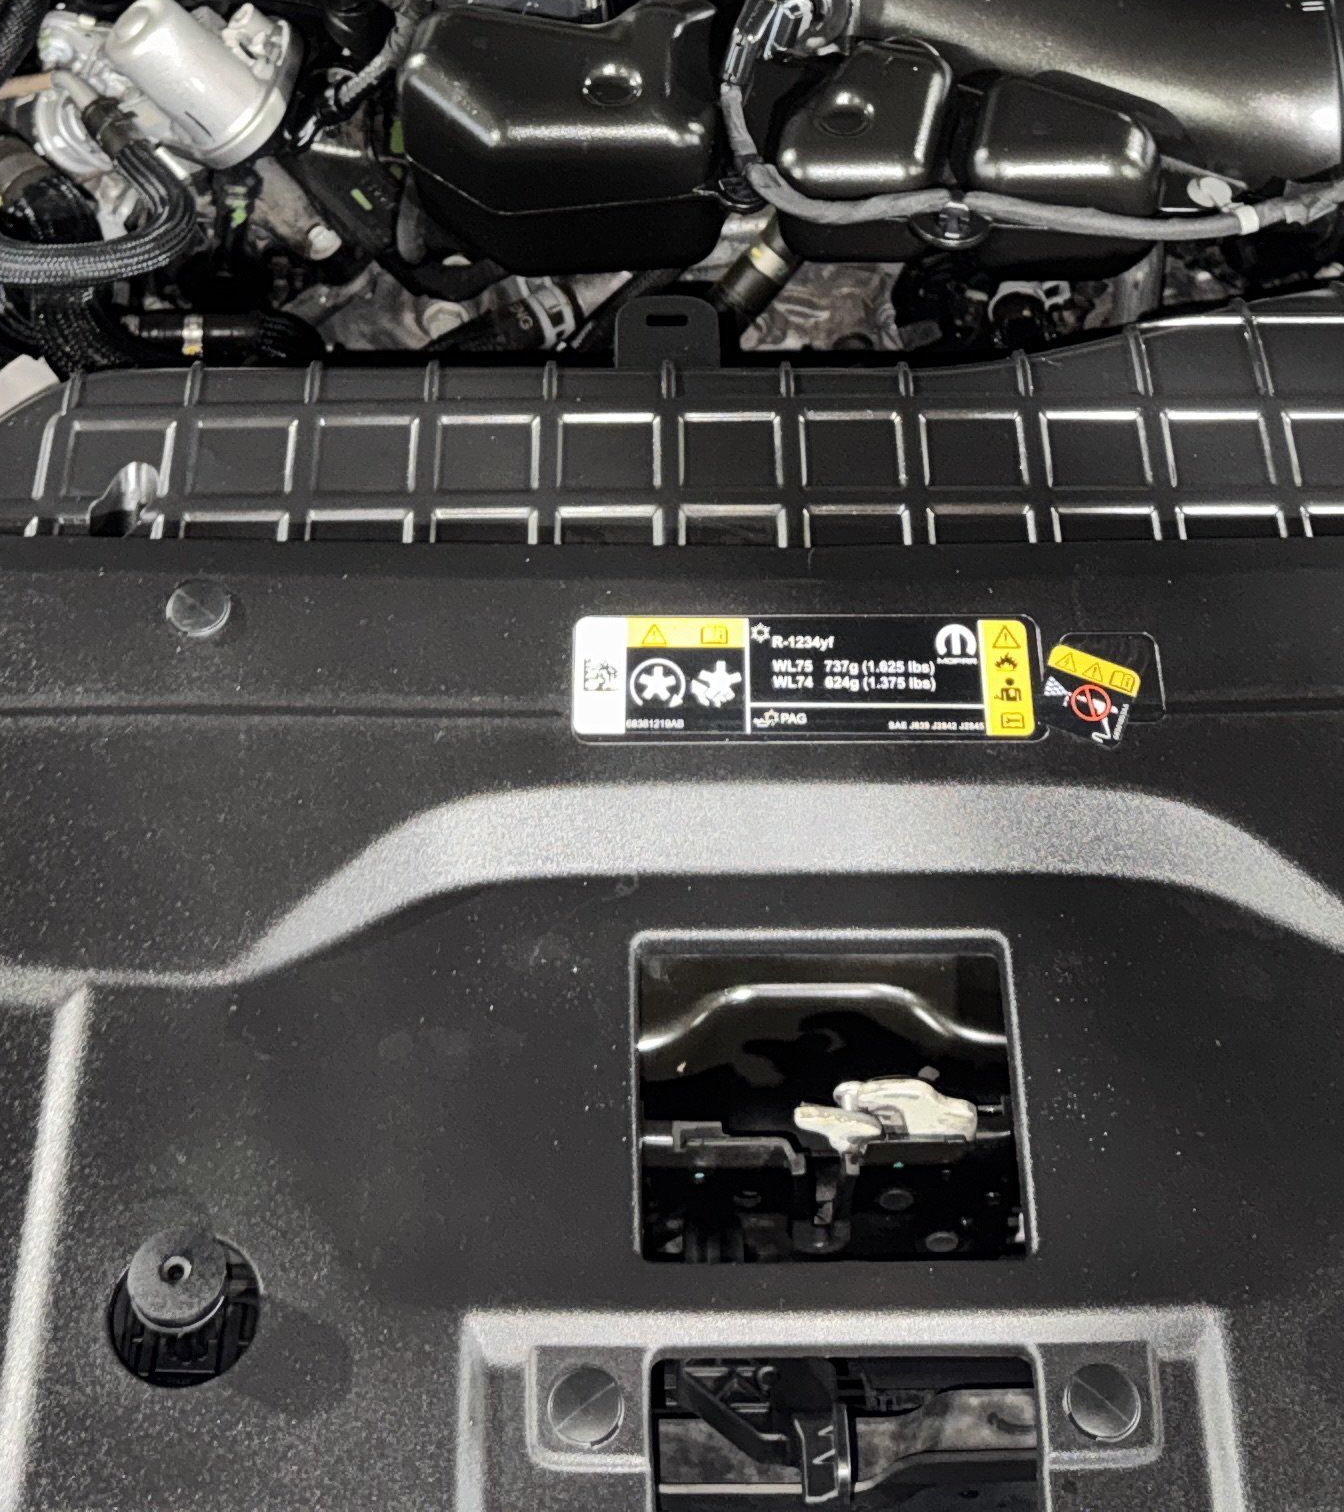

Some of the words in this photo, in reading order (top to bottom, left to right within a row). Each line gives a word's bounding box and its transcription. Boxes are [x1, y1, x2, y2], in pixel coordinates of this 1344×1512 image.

[771, 635, 835, 652] R-1234yf
[771, 659, 814, 673] WL75
[823, 659, 859, 675] 737g
[862, 659, 905, 675] (1.625
[908, 659, 936, 676] lbs)
[771, 675, 814, 689] WL74
[824, 676, 860, 692] 624g
[862, 676, 906, 692] (1.375
[909, 676, 937, 692] lbs)
[780, 712, 808, 725] PAG
[887, 720, 908, 730] SAE
